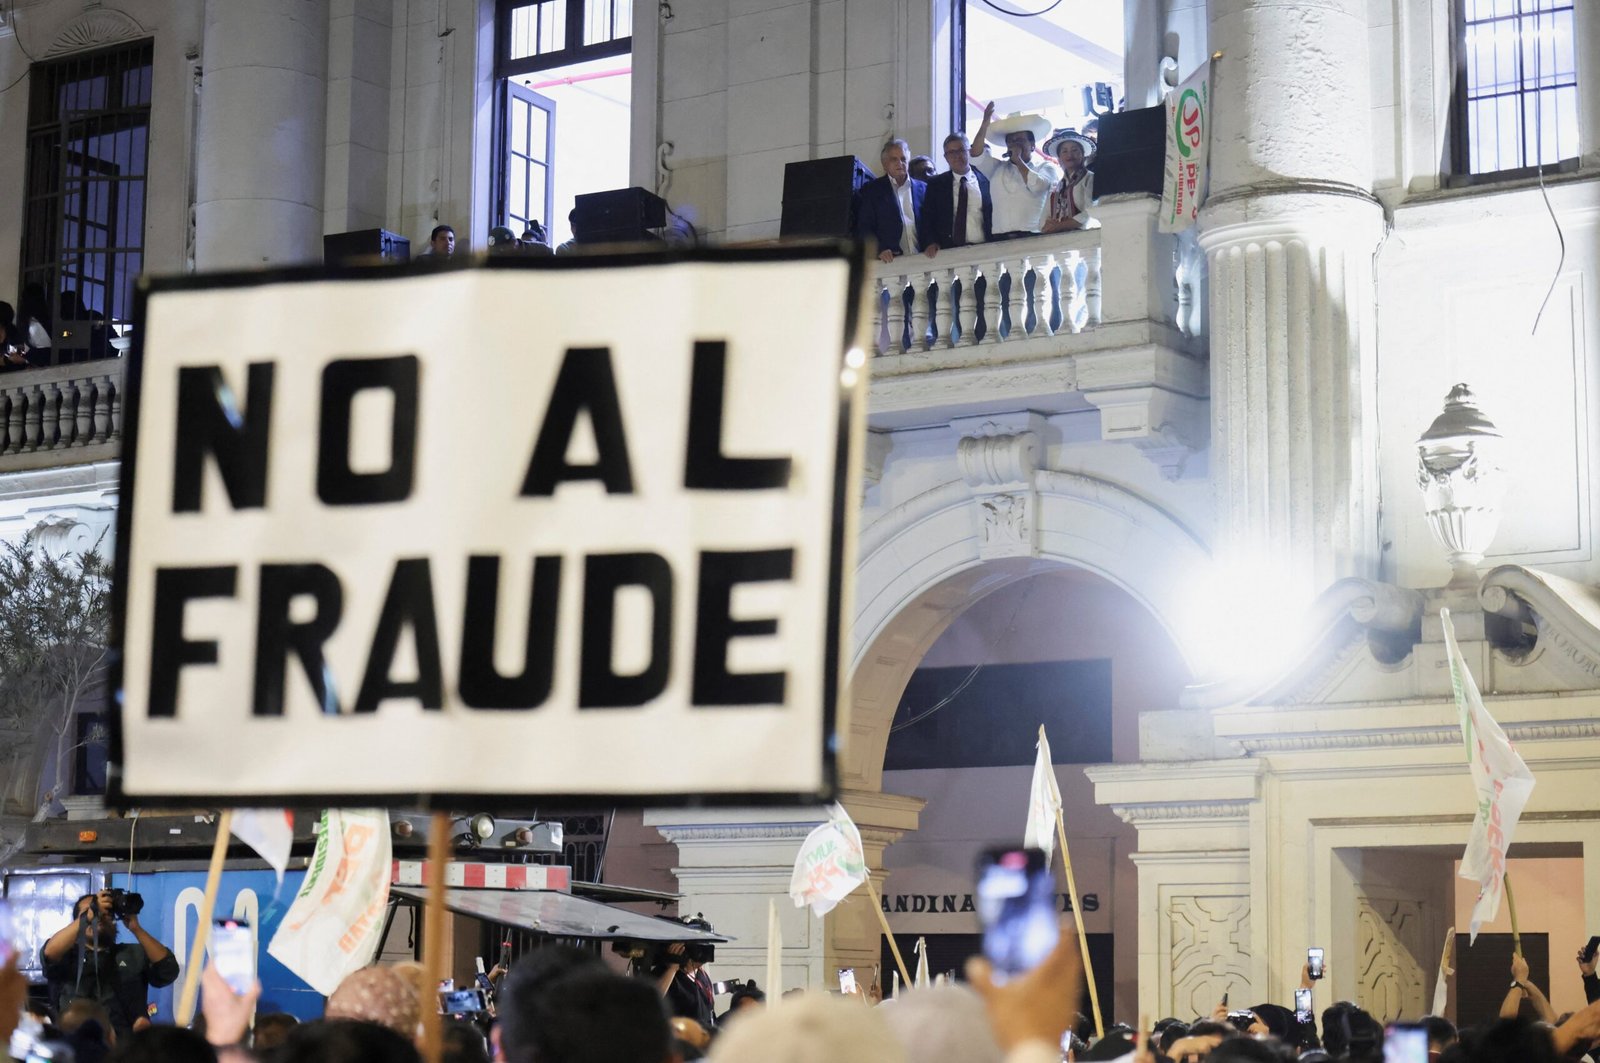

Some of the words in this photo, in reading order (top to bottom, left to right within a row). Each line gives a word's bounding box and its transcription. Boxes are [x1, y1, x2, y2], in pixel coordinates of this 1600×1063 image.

[1176, 173, 1184, 215] LIBERTAD
[173, 354, 421, 514] NO
[518, 338, 793, 497] AL
[147, 548, 795, 719] FRAUDE
[881, 894, 976, 913] ANDINA
